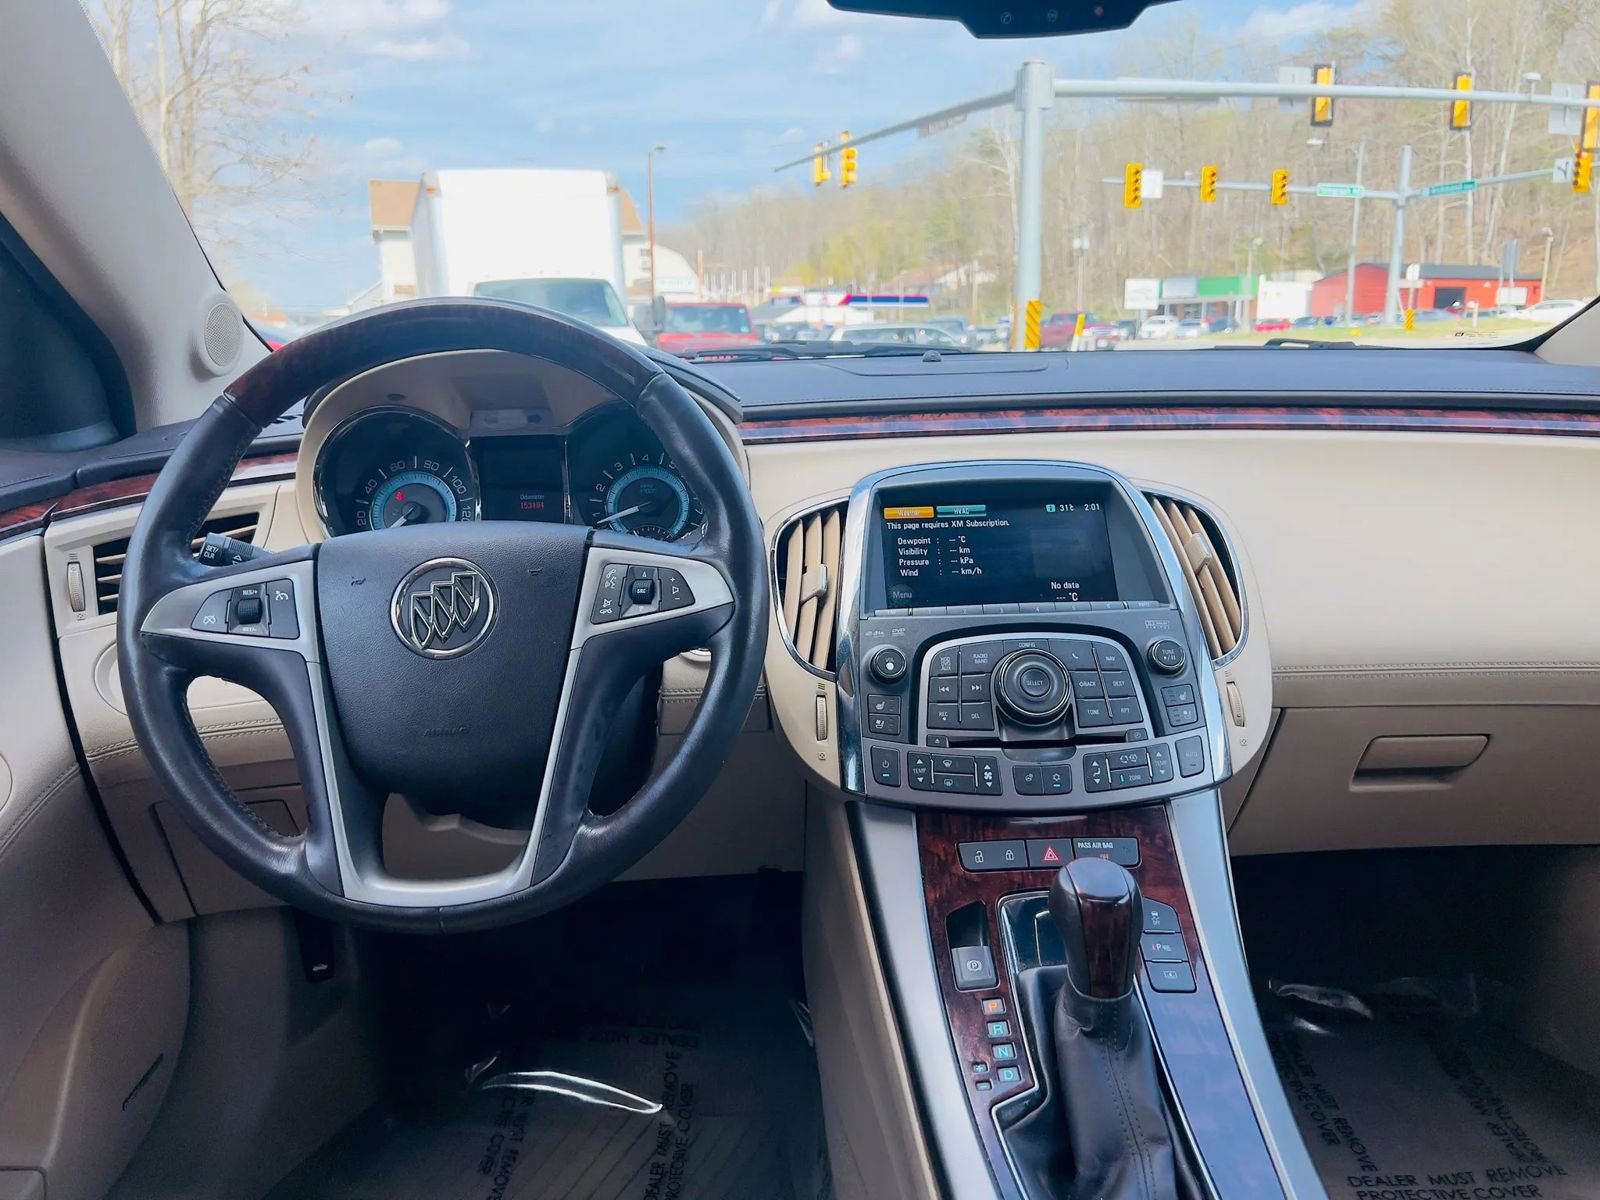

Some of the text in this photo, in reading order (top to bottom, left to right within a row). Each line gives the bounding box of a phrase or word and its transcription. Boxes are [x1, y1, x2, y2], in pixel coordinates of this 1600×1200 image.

[390, 460, 406, 472] 60
[424, 460, 440, 472] 80
[614, 462, 624, 472] 3
[364, 479, 378, 495] 40
[450, 475, 468, 495] 100
[595, 483, 606, 492] 2
[356, 510, 368, 527] 20
[886, 518, 1010, 530] This page requires XM Subscription.
[897, 537, 931, 546] Dewpoint
[206, 544, 219, 553] SET/
[898, 548, 928, 556] Visibility
[204, 552, 215, 560] CLR
[898, 556, 974, 566] Pressure kPa
[900, 567, 982, 577] Wind km/h
[1063, 582, 1080, 590] data
[988, 1002, 998, 1012] P
[993, 1024, 1004, 1034] R
[998, 1047, 1008, 1057] N
[1004, 1070, 1014, 1080] D
[1304, 1102, 1342, 1146] COVER
[656, 1122, 673, 1157] MUST
[1332, 1117, 1382, 1173] REMOVE
[1346, 1164, 1569, 1188] DEALER MUST REMOVE
[1356, 1184, 1544, 1200] PROTECTIVE COVER
